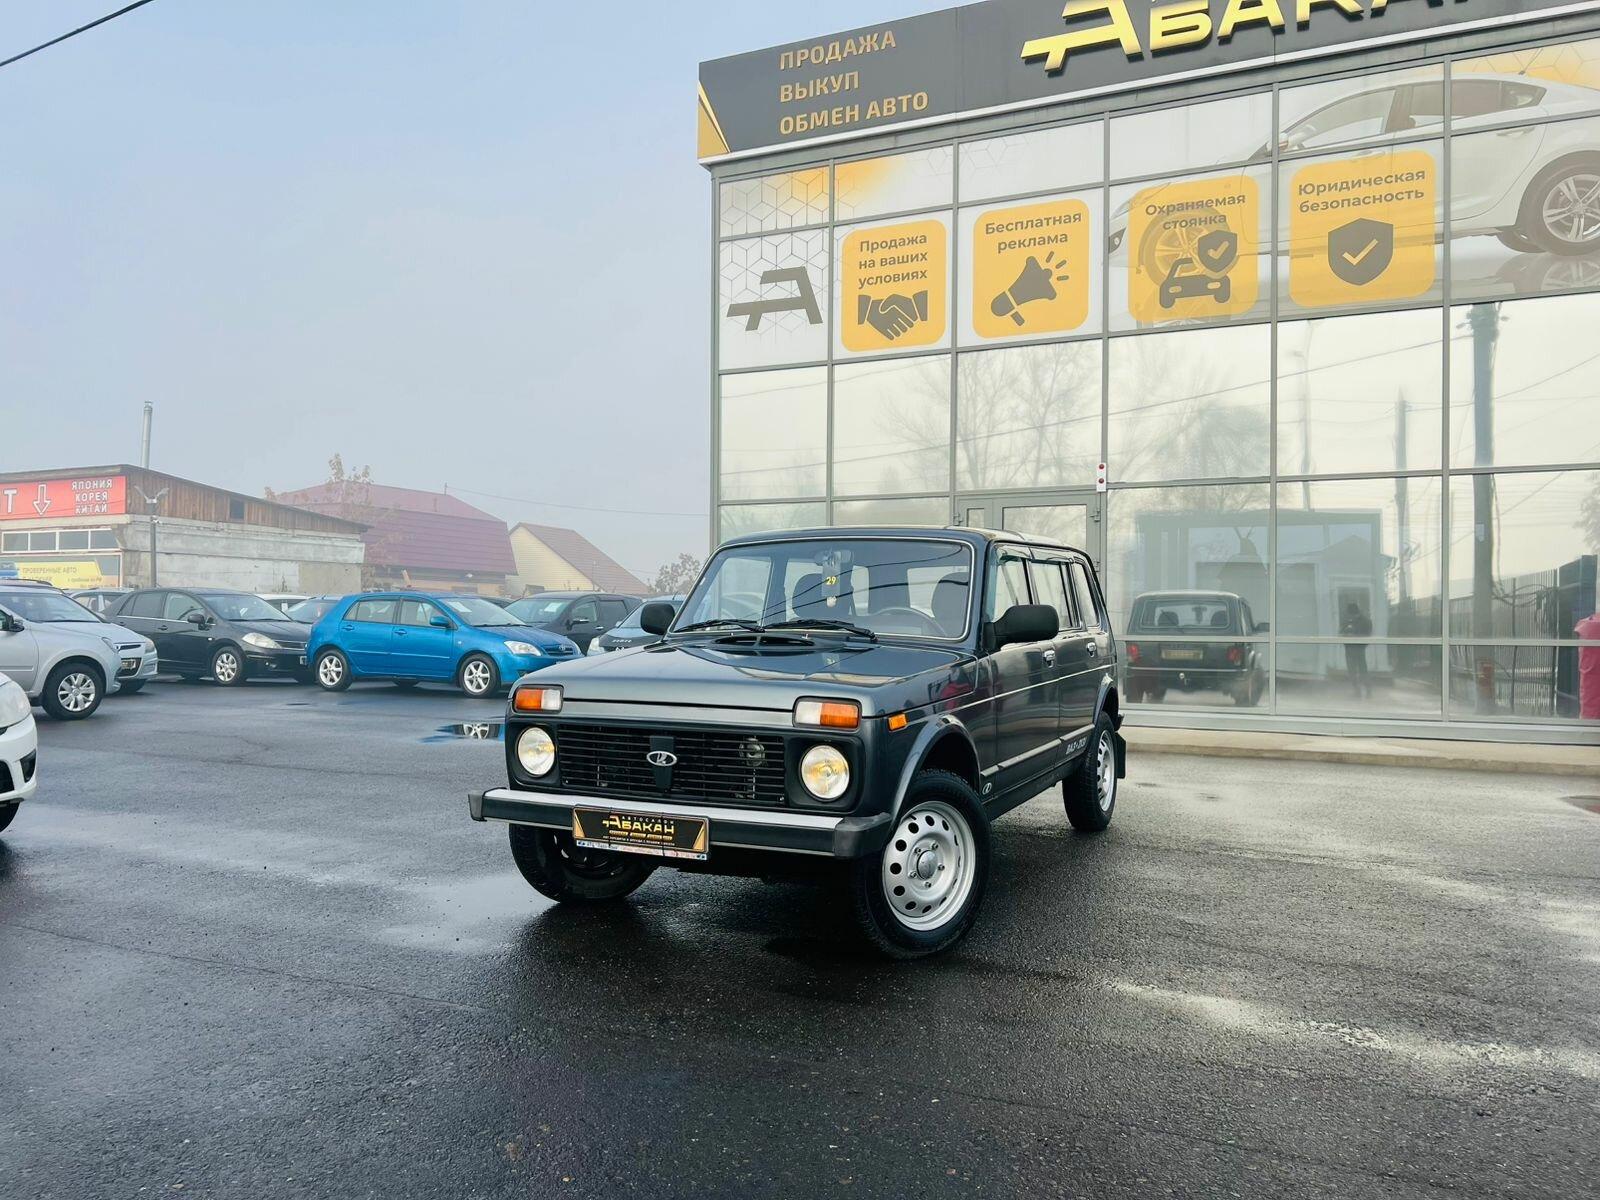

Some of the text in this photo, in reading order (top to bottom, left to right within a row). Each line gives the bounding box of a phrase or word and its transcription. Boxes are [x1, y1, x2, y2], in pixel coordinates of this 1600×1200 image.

[779, 30, 896, 70] ПРОДАЖА
[779, 71, 860, 102] ВЫКУП
[779, 91, 929, 135] ОБМЕН АВТО
[1298, 169, 1426, 197] Юридическая
[1145, 193, 1246, 216] Охраняемая
[1298, 188, 1425, 213] безопасность
[985, 212, 1082, 235] Бесплатная
[1162, 213, 1227, 231] стоянка
[859, 233, 927, 254] Продажа
[997, 232, 1068, 254] реклама
[858, 251, 928, 270] на ваших
[857, 269, 928, 289] условиях
[71, 479, 113, 490] ЯПОНИЯ
[75, 491, 108, 502] КОРЕЯ
[75, 502, 108, 514] КИТАЙ
[826, 576, 837, 585] 29
[602, 815, 675, 834] АБАКАН
